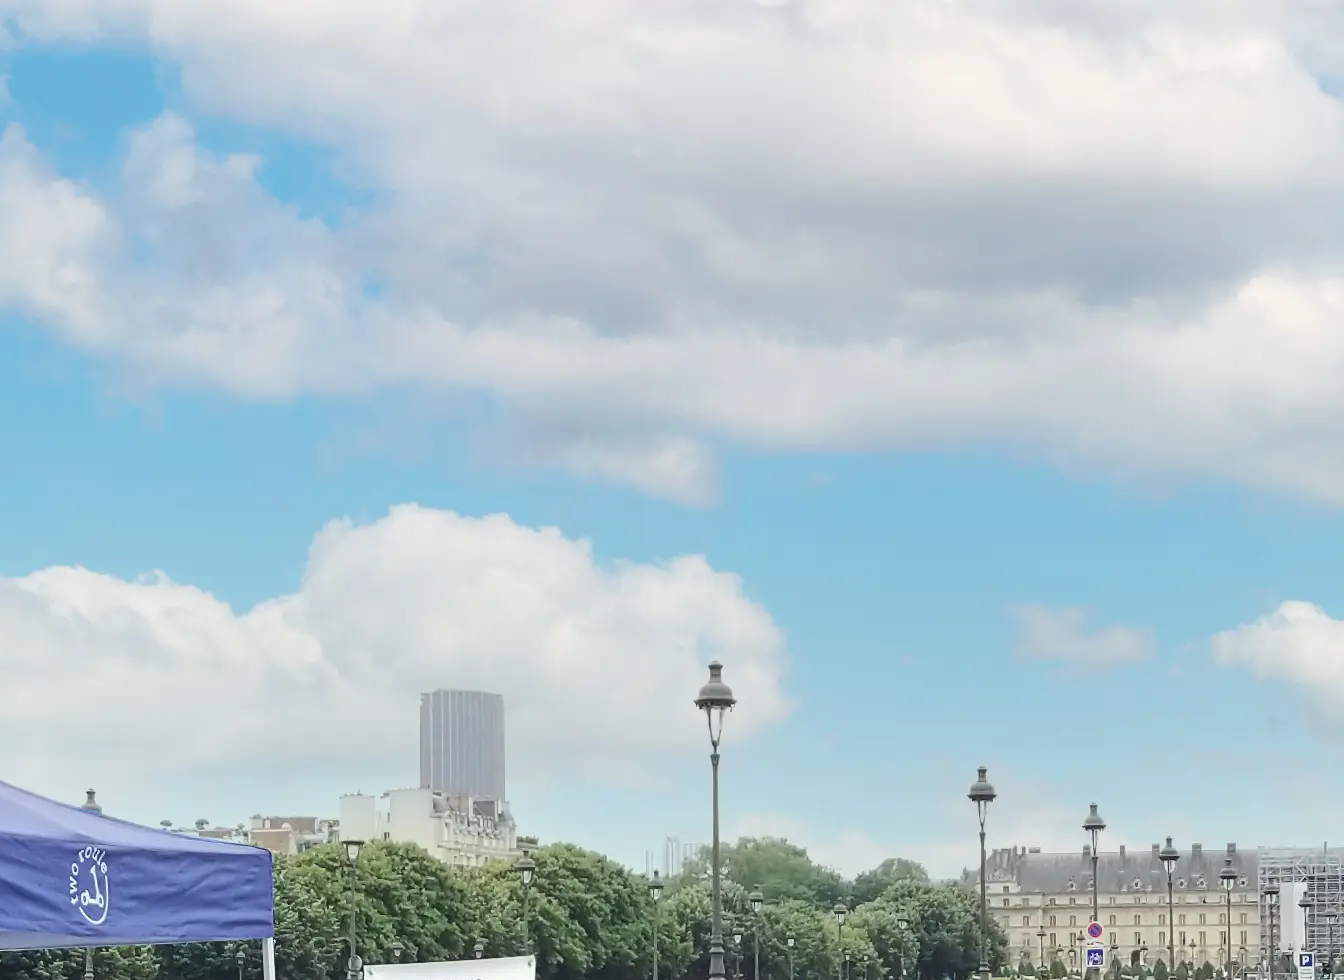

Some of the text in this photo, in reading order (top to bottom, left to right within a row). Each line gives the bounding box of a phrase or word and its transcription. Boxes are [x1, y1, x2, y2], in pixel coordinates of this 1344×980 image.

[68, 846, 108, 906] two roule
[1302, 955, 1310, 966] P
